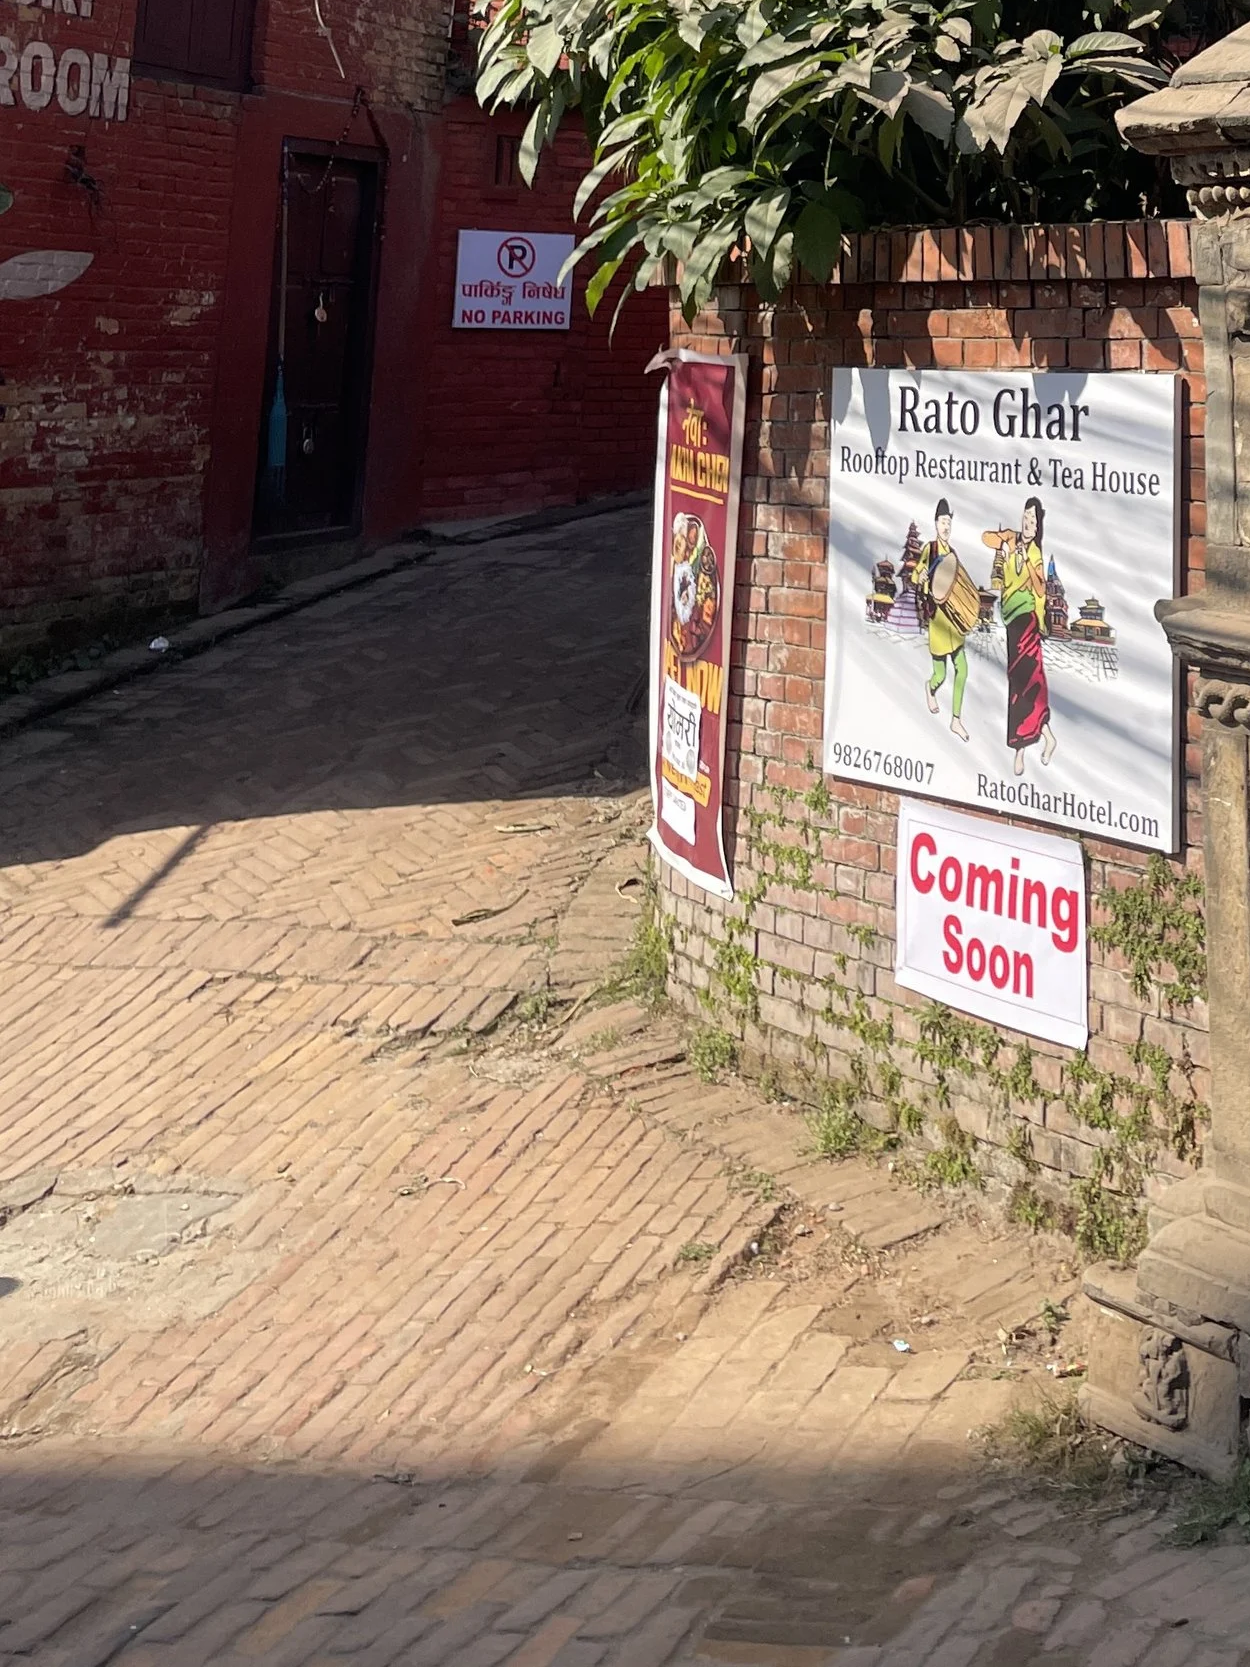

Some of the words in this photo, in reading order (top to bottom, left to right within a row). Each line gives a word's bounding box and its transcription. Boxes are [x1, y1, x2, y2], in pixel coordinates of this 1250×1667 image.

[461, 310, 486, 324] NO
[491, 310, 565, 325] PARKING
[898, 386, 980, 435] Rato
[993, 388, 1090, 442] Ghar
[840, 446, 908, 484] Rooftop
[915, 450, 1022, 485] Restaurant
[1027, 459, 1043, 486] &
[1048, 458, 1085, 490] Tea
[1092, 462, 1160, 496] House
[833, 742, 935, 785] 9826768007
[977, 774, 1160, 838] RatoGharHotel.com
[910, 832, 1079, 954] Coming
[943, 914, 1034, 999] Soon
